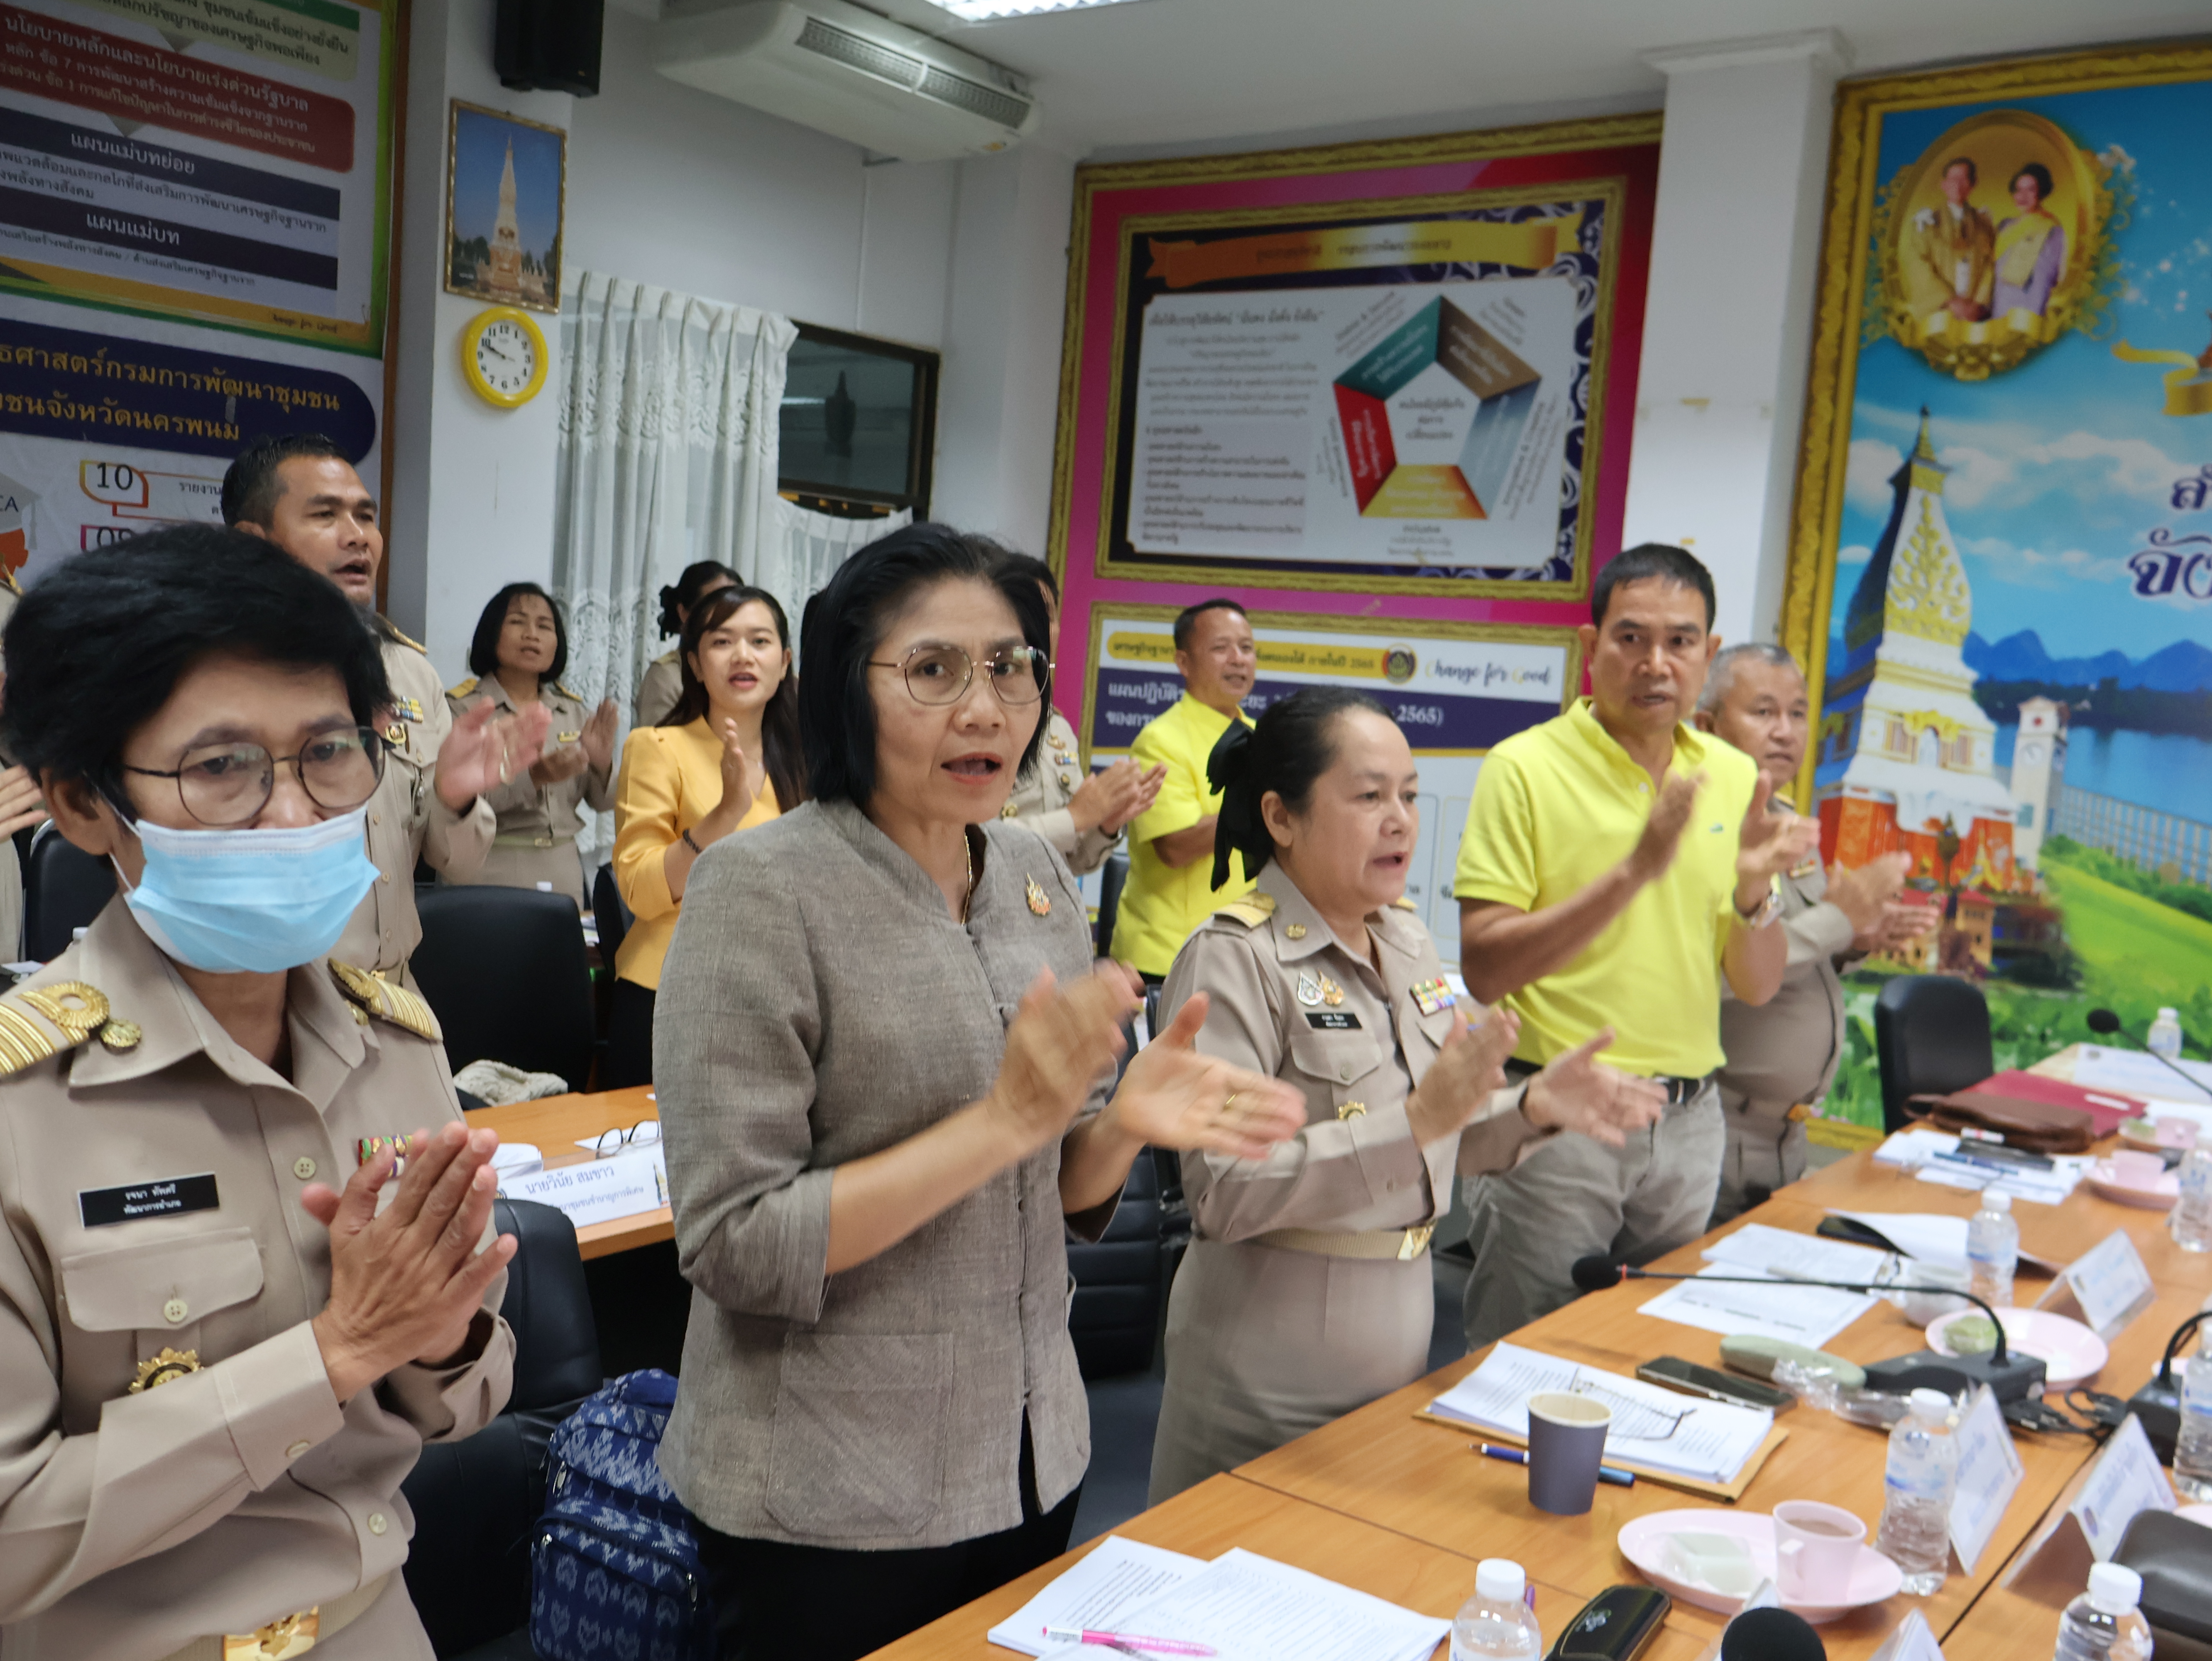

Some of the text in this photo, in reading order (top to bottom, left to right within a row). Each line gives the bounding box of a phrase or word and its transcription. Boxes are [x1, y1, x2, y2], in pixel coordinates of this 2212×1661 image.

[64, 58, 71, 69] 7
[71, 132, 195, 174] แผนแม่บทย่อย
[86, 213, 180, 246] แผนแม่บท
[0, 390, 240, 441] ชนจังหวัดนครพนม
[97, 462, 133, 490] 10
[1483, 662, 1507, 687] for
